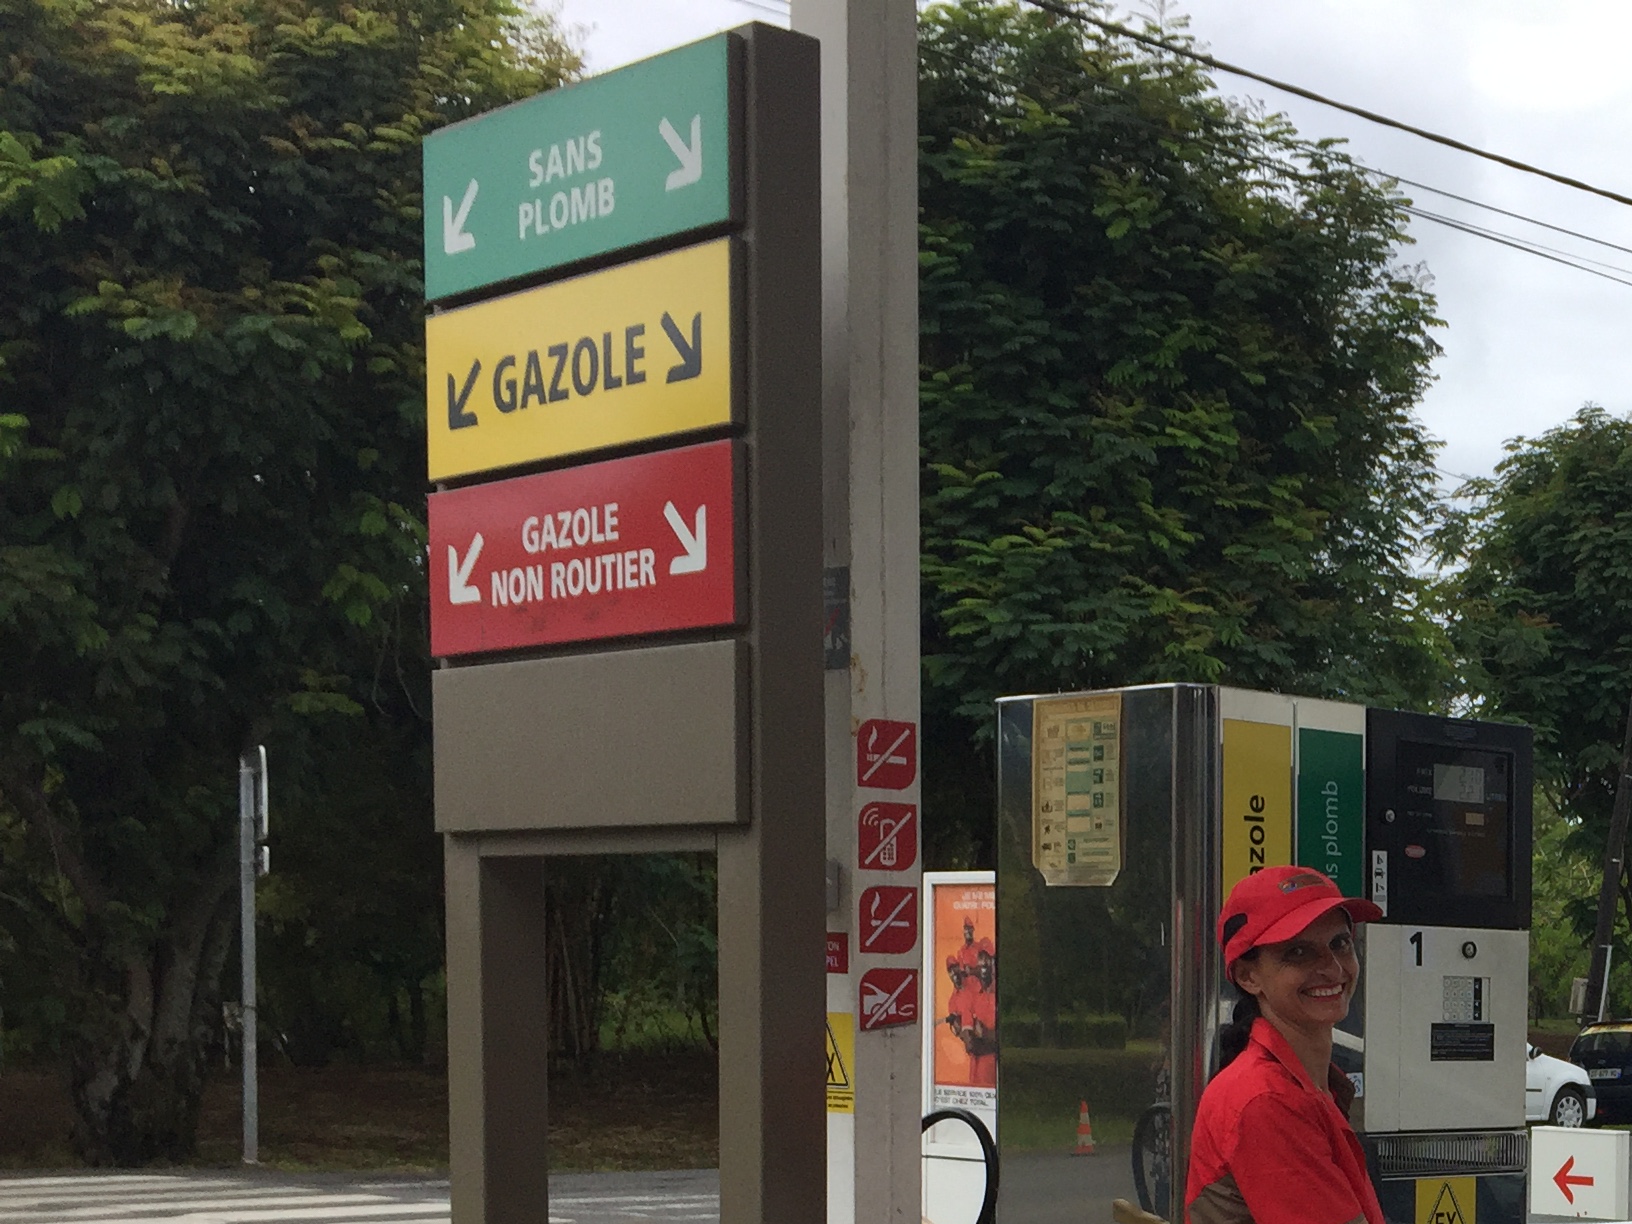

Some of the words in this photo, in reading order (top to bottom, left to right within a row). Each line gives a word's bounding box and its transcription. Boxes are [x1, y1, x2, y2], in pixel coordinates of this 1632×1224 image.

[528, 131, 604, 188] SANS
[518, 178, 616, 241] PLOMB
[491, 323, 648, 415] GAZOLE
[521, 502, 620, 554] GAZOLE
[490, 563, 545, 607] NON
[550, 547, 657, 599] ROUTIER
[1320, 780, 1343, 857] plomb
[1409, 931, 1423, 967] 1
